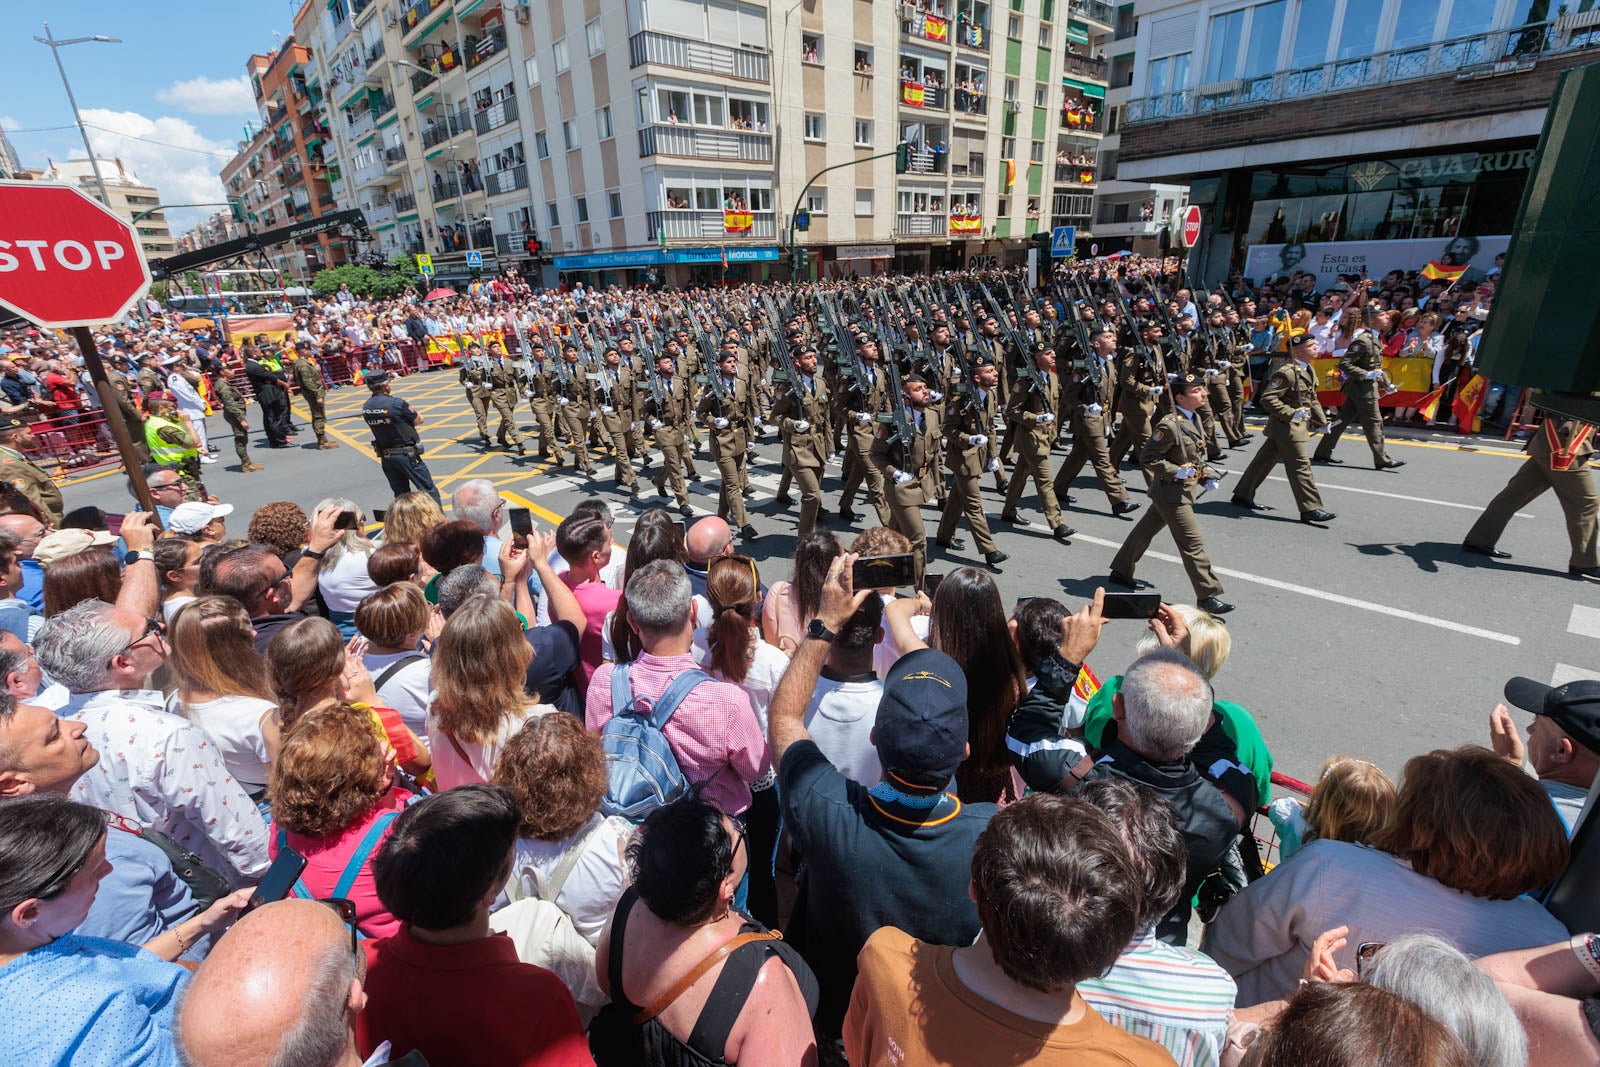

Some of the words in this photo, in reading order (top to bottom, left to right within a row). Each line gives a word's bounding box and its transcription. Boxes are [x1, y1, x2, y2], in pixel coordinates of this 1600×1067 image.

[1400, 155, 1466, 178] CAJA
[1186, 222, 1199, 231] STOP
[0, 239, 125, 272] STOP
[1322, 254, 1349, 264] Esta
[1351, 254, 1366, 263] es
[1320, 264, 1333, 273] tu
